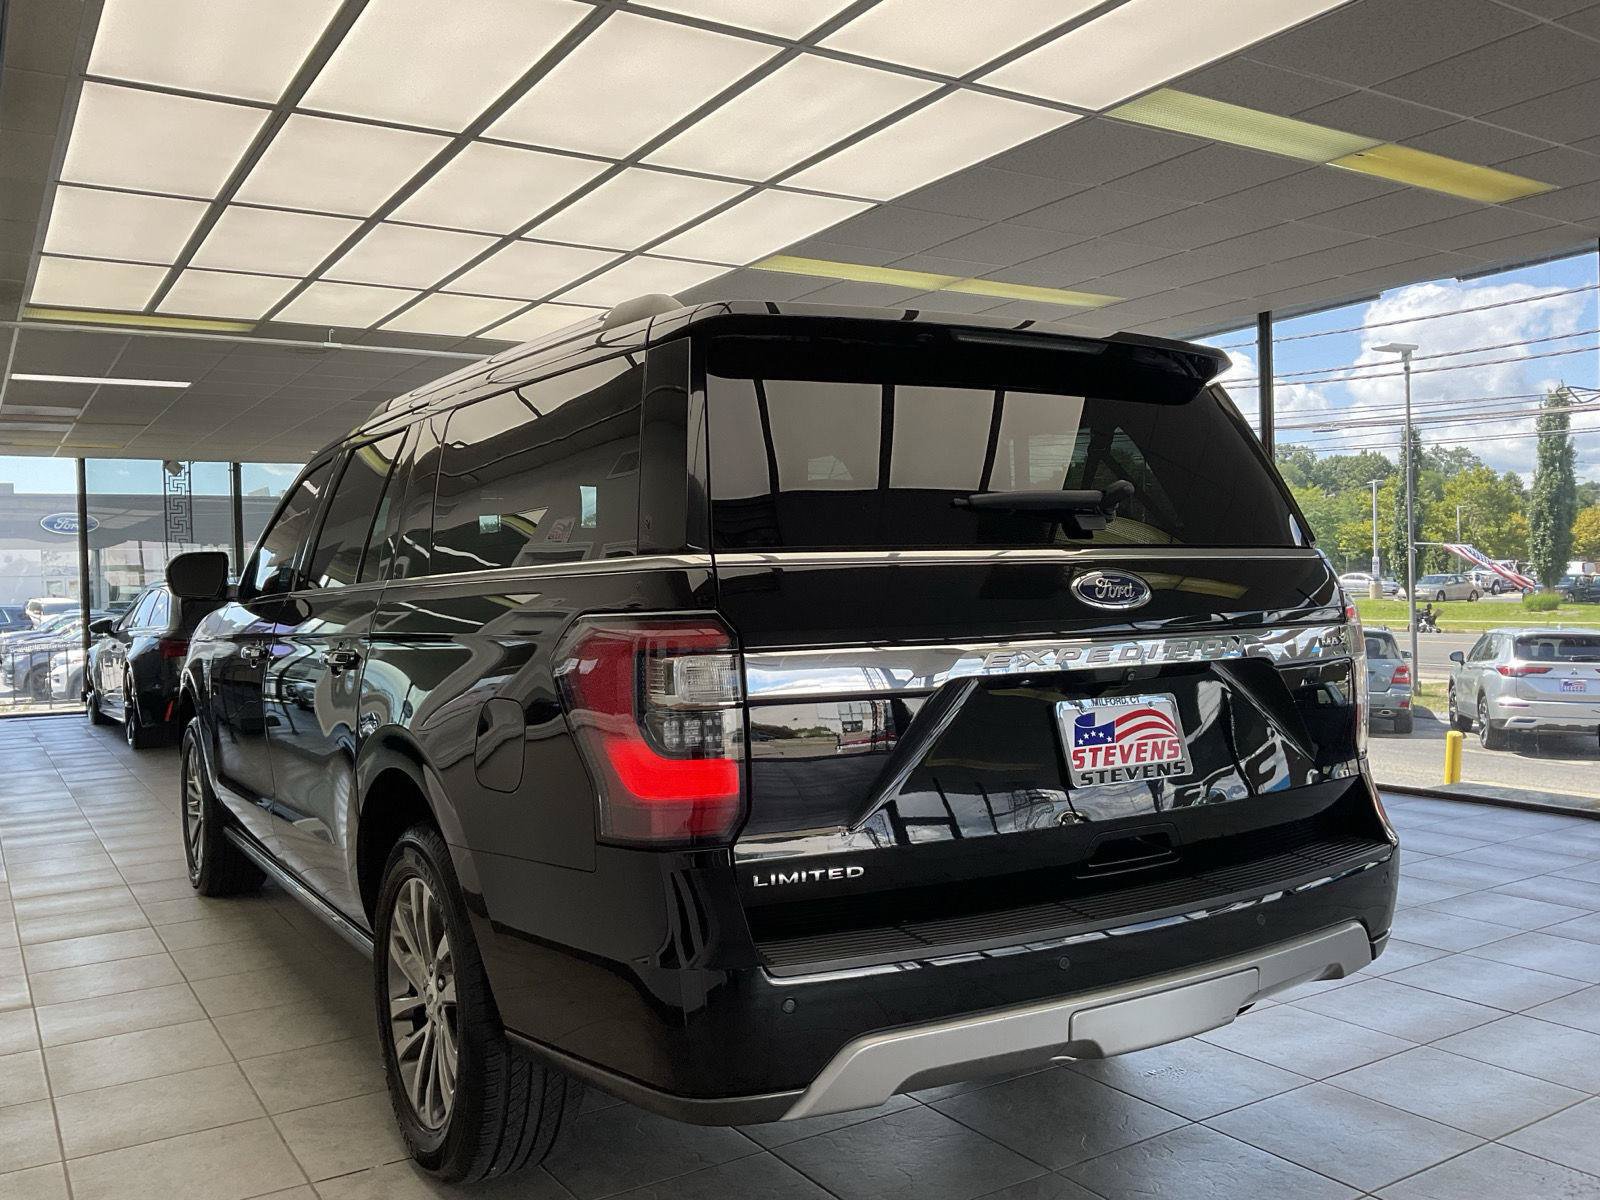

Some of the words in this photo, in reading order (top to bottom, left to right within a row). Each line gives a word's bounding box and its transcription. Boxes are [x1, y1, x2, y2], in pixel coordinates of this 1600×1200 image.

[54, 517, 81, 530] For
[1095, 577, 1136, 598] Ford
[983, 634, 1247, 669] EXPEDITION
[1072, 739, 1180, 769] STEVENS
[1080, 760, 1186, 786] STEVENS
[753, 866, 865, 887] LIMITED
